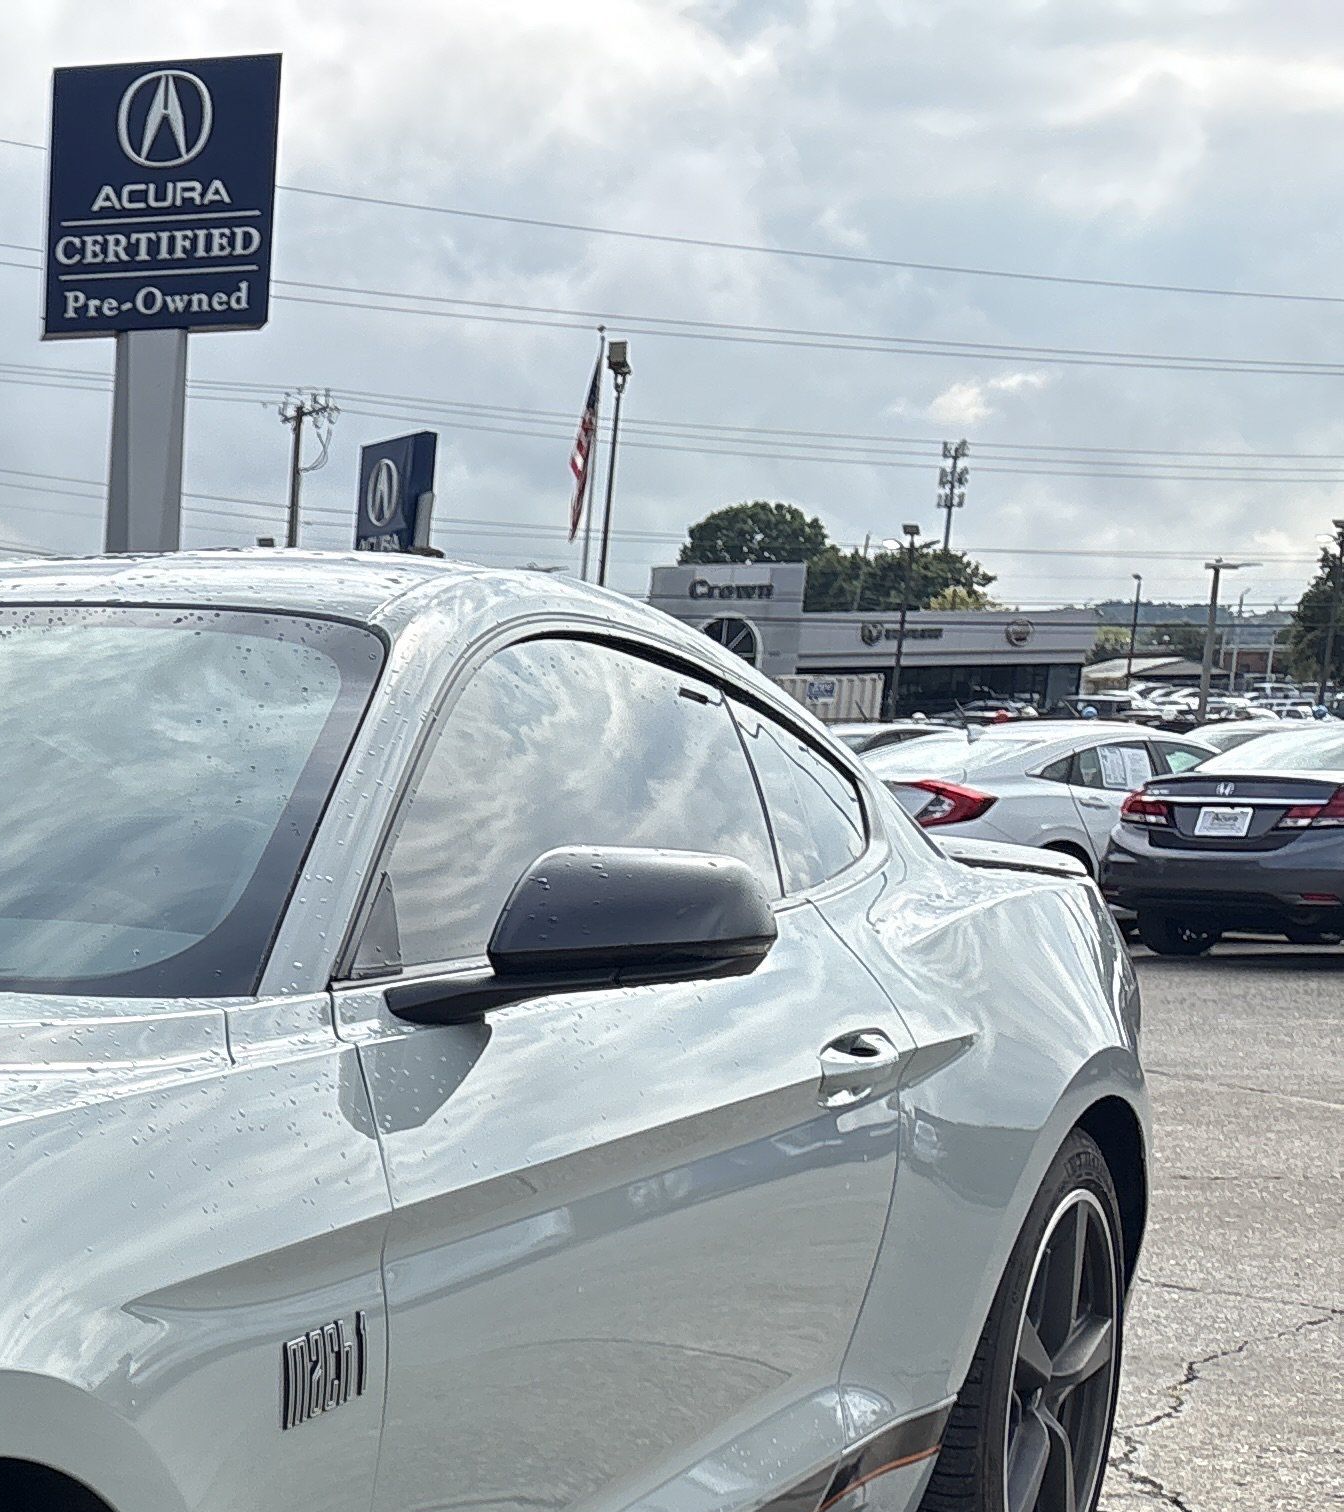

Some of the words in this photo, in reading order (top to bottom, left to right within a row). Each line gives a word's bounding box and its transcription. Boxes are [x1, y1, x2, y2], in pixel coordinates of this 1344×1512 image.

[91, 179, 232, 212] ACURA
[55, 226, 261, 266] CERTIFIED
[63, 280, 250, 319] Pre-Owned
